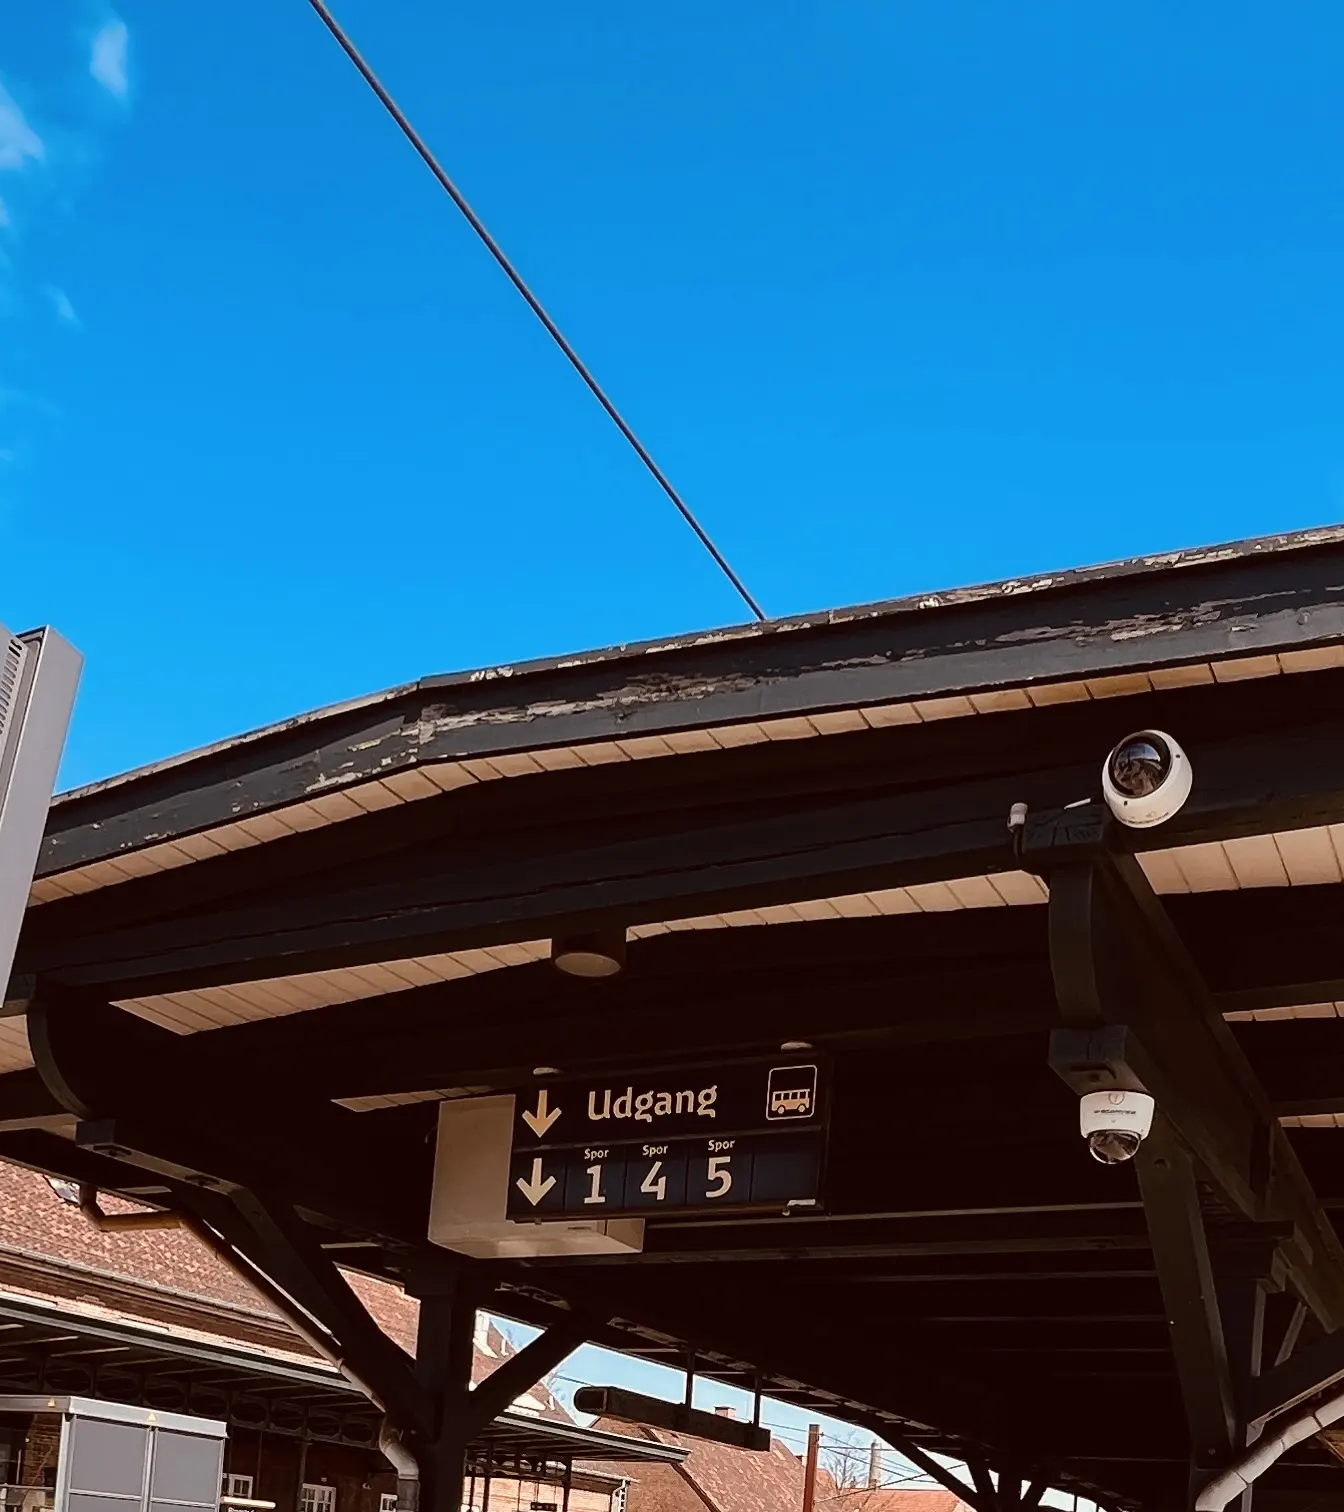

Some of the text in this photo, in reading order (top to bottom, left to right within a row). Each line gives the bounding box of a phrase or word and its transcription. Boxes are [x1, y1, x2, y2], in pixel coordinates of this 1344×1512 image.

[587, 1085, 718, 1122] Udgang
[584, 1139, 735, 1161] Spor Spor Spor
[583, 1156, 732, 1204] 1 4 5
